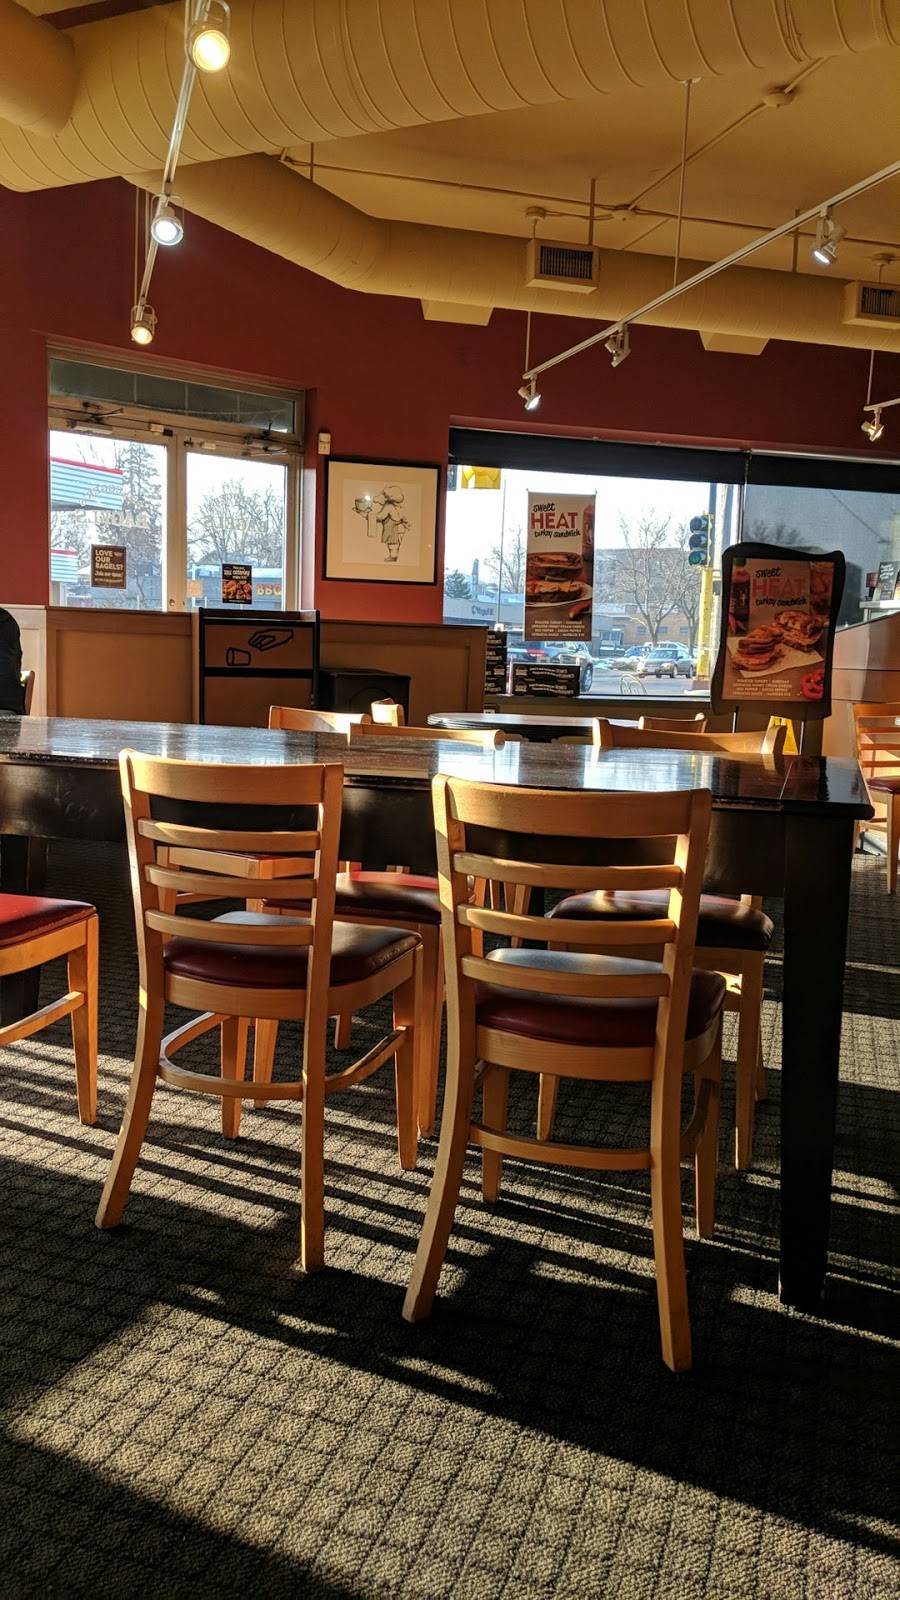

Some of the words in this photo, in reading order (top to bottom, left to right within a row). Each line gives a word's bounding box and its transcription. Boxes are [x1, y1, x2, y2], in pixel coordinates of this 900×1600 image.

[532, 502, 556, 512] sweet
[531, 511, 578, 529] HEAT
[534, 529, 553, 539] turkey
[553, 529, 581, 538] sandwich
[95, 549, 113, 557] LOVE
[95, 562, 124, 571] BAGELS?
[755, 567, 782, 577] sweet
[752, 576, 804, 598] HEAT
[755, 597, 776, 606] turkey
[776, 597, 807, 606] sandwich
